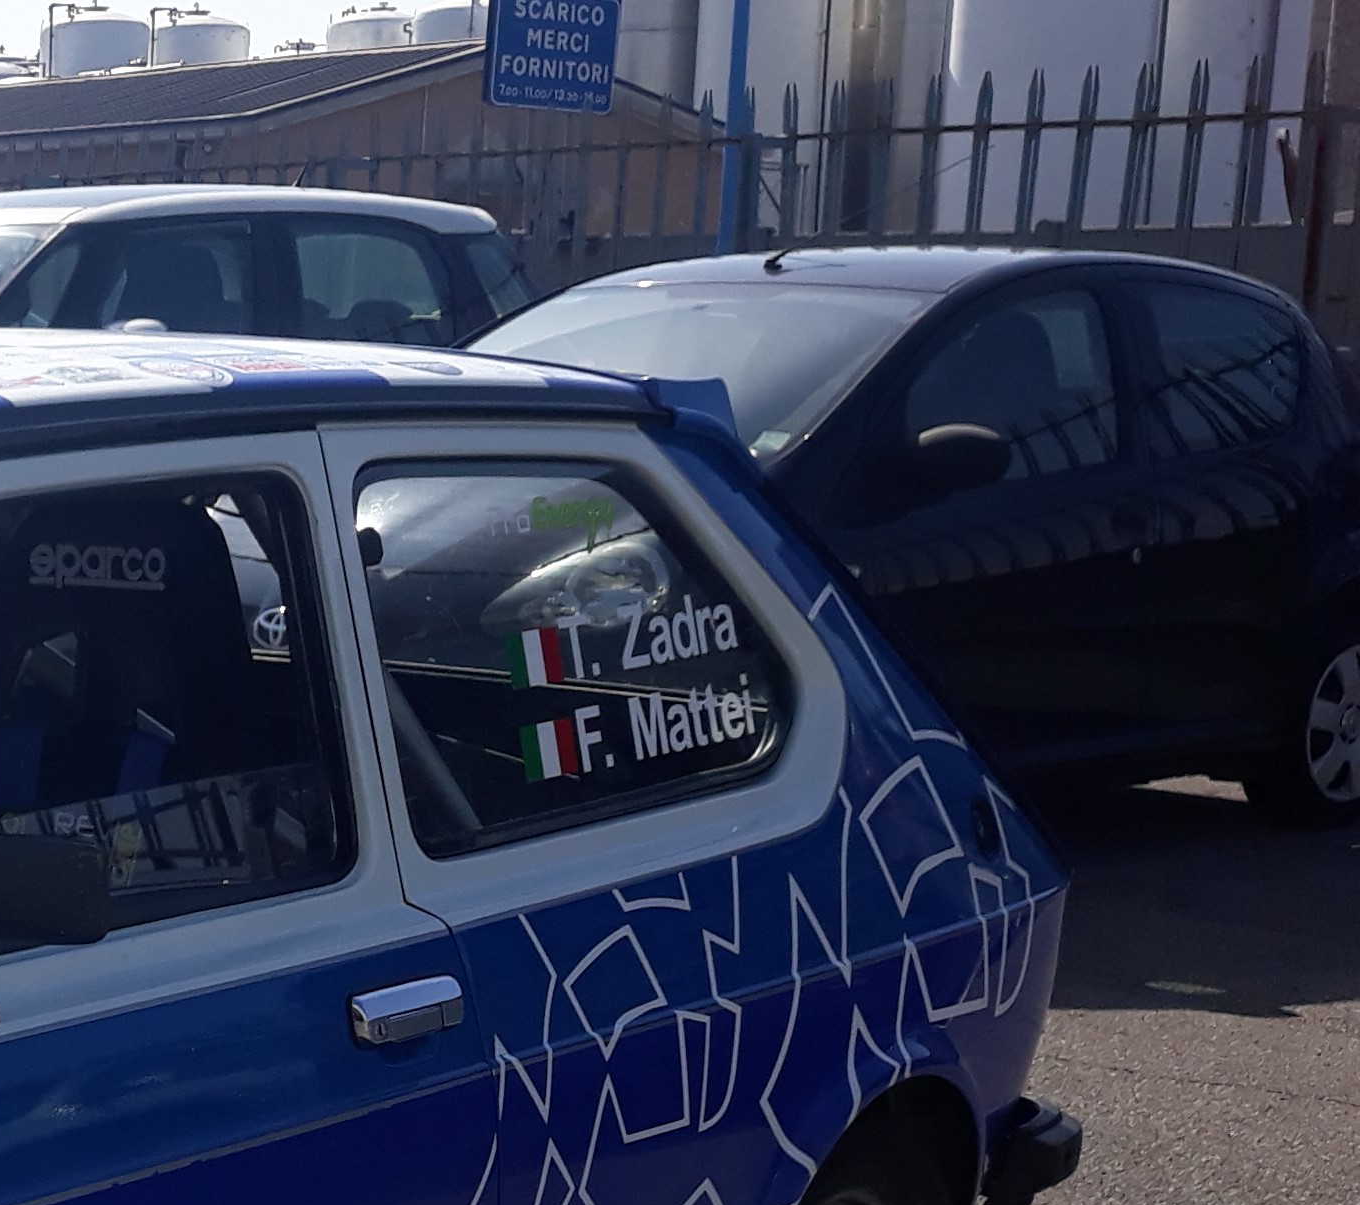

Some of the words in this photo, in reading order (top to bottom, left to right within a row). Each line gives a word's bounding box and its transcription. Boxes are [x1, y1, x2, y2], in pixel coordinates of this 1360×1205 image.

[515, 0, 605, 26] SCARICO
[527, 28, 590, 53] MERCI
[500, 55, 609, 84] FORNITORI
[29, 543, 166, 589] sparco
[557, 612, 601, 679] T.
[618, 594, 739, 671] Zadra
[575, 705, 615, 773] F.
[628, 673, 756, 761] Mattei
